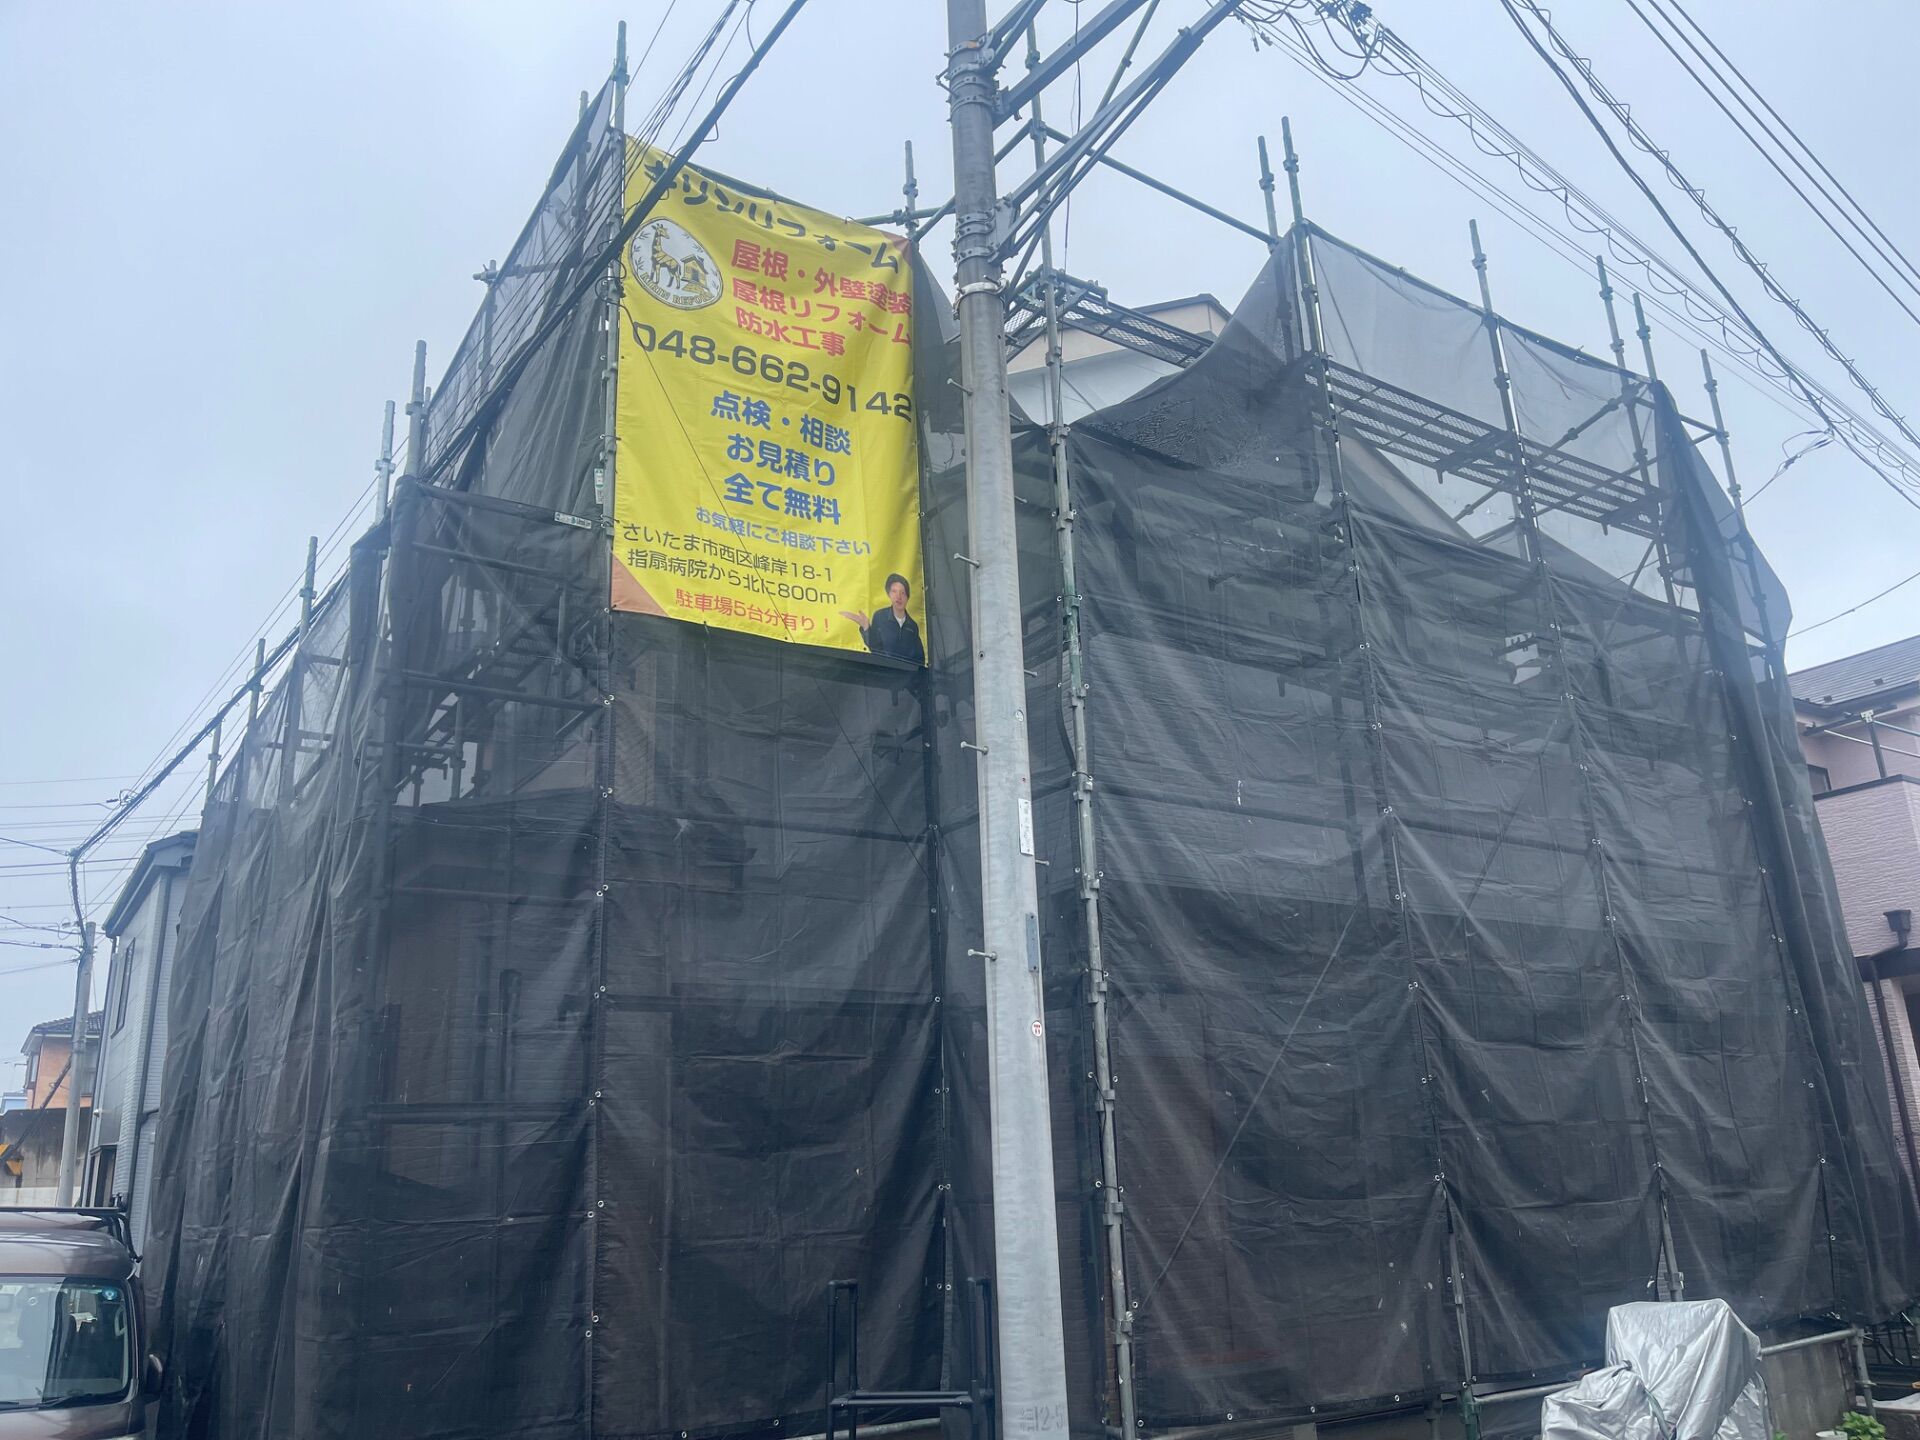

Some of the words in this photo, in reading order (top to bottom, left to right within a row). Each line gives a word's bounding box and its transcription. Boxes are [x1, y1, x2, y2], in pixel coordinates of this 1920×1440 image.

[731, 239, 912, 317] 屋根・外壁塗装
[732, 277, 911, 349] 屋根リフォーム
[735, 306, 846, 357] 防水工事
[632, 321, 912, 422] 048-662-9142
[711, 390, 851, 456] 点検・相談
[727, 433, 835, 487] お見積り
[724, 472, 841, 525] 全て無料
[623, 523, 832, 583] さいたま市西区峰岸18-1
[695, 507, 870, 556] お気軽にご相談下さい
[627, 548, 837, 604] 指扇病院から北に800m
